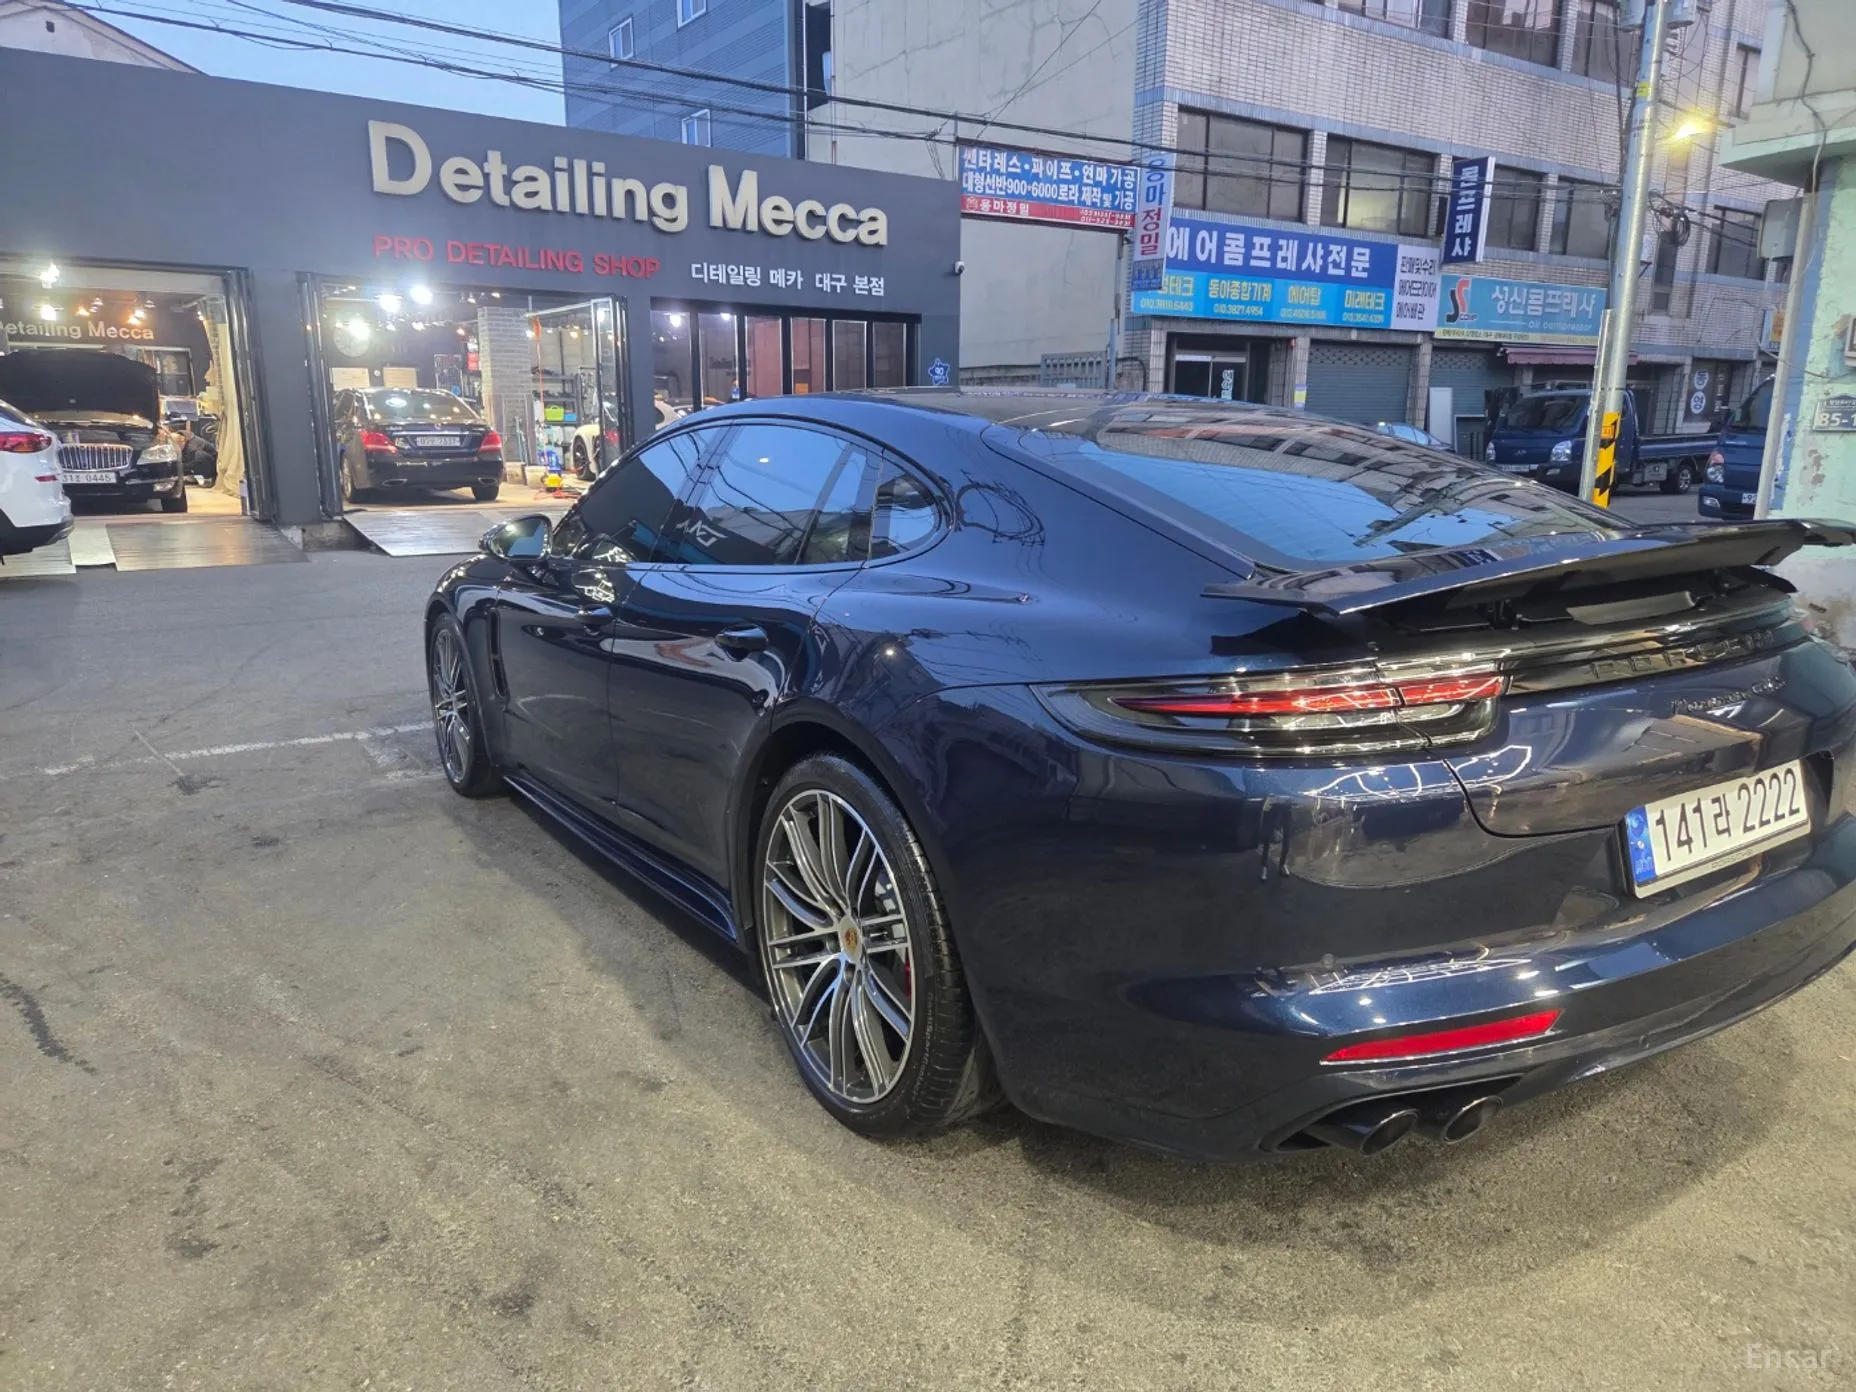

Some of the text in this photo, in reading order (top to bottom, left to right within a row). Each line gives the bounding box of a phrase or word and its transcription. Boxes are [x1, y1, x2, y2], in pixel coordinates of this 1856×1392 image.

[368, 119, 889, 246] Detailing Mecca
[1451, 166, 1479, 257] 콤프레샤
[373, 234, 660, 279] PRO DETAILING SHOP
[1167, 227, 1371, 278] 에어콤프레샤전문
[691, 262, 885, 297] 디테일링 메카 대구 본점
[0, 320, 155, 340] etailing Mecca
[1655, 767, 1801, 862] 141라 2222
